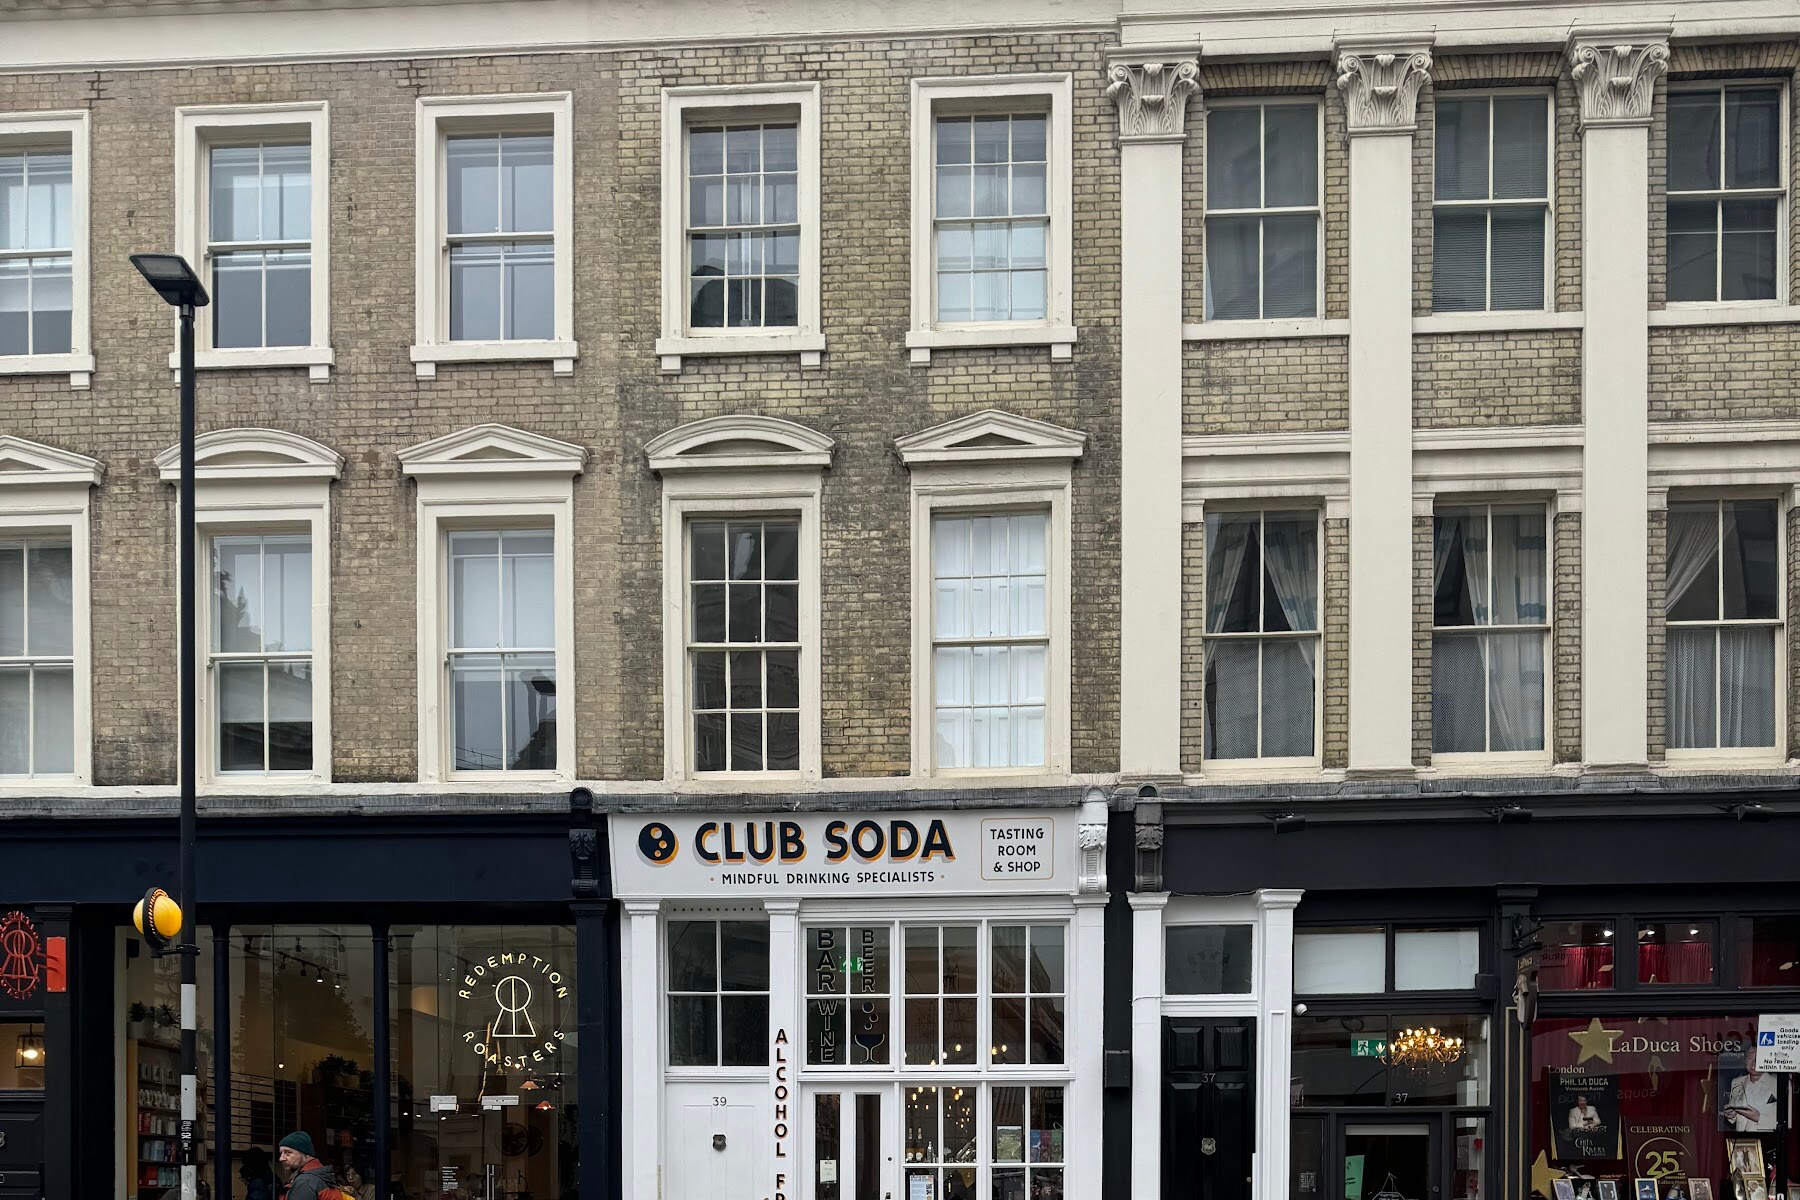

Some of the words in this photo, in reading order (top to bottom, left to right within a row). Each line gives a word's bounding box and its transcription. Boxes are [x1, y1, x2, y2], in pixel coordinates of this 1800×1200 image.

[989, 828, 1045, 841] TASTING
[694, 821, 806, 864] CLUB
[824, 819, 956, 864] SODA
[998, 844, 1037, 857] ROOM
[993, 862, 1003, 873] &
[1007, 861, 1041, 873] SHOP
[722, 873, 780, 885] MINDFUL
[786, 873, 850, 885] DRINKING
[857, 871, 935, 884] SPECIALISTS
[815, 929, 837, 992] BAR
[861, 930, 875, 992] BEER
[458, 952, 568, 999] REDEMPTION
[817, 1000, 838, 1063] WINE
[463, 1030, 565, 1067] ROASTERS
[1609, 1036, 1680, 1053] LaDuca
[1690, 1036, 1742, 1053] Shoes
[1548, 1064, 1585, 1074] London
[1201, 1073, 1216, 1083] 37
[1560, 1078, 1577, 1086] PHIL
[1578, 1078, 1588, 1086] LA
[1588, 1078, 1609, 1086] DUCA
[774, 1028, 789, 1158] ALCOHOL
[1395, 1093, 1409, 1104] 37
[712, 1097, 727, 1107] 39
[1630, 1125, 1690, 1133] CELEBRATING
